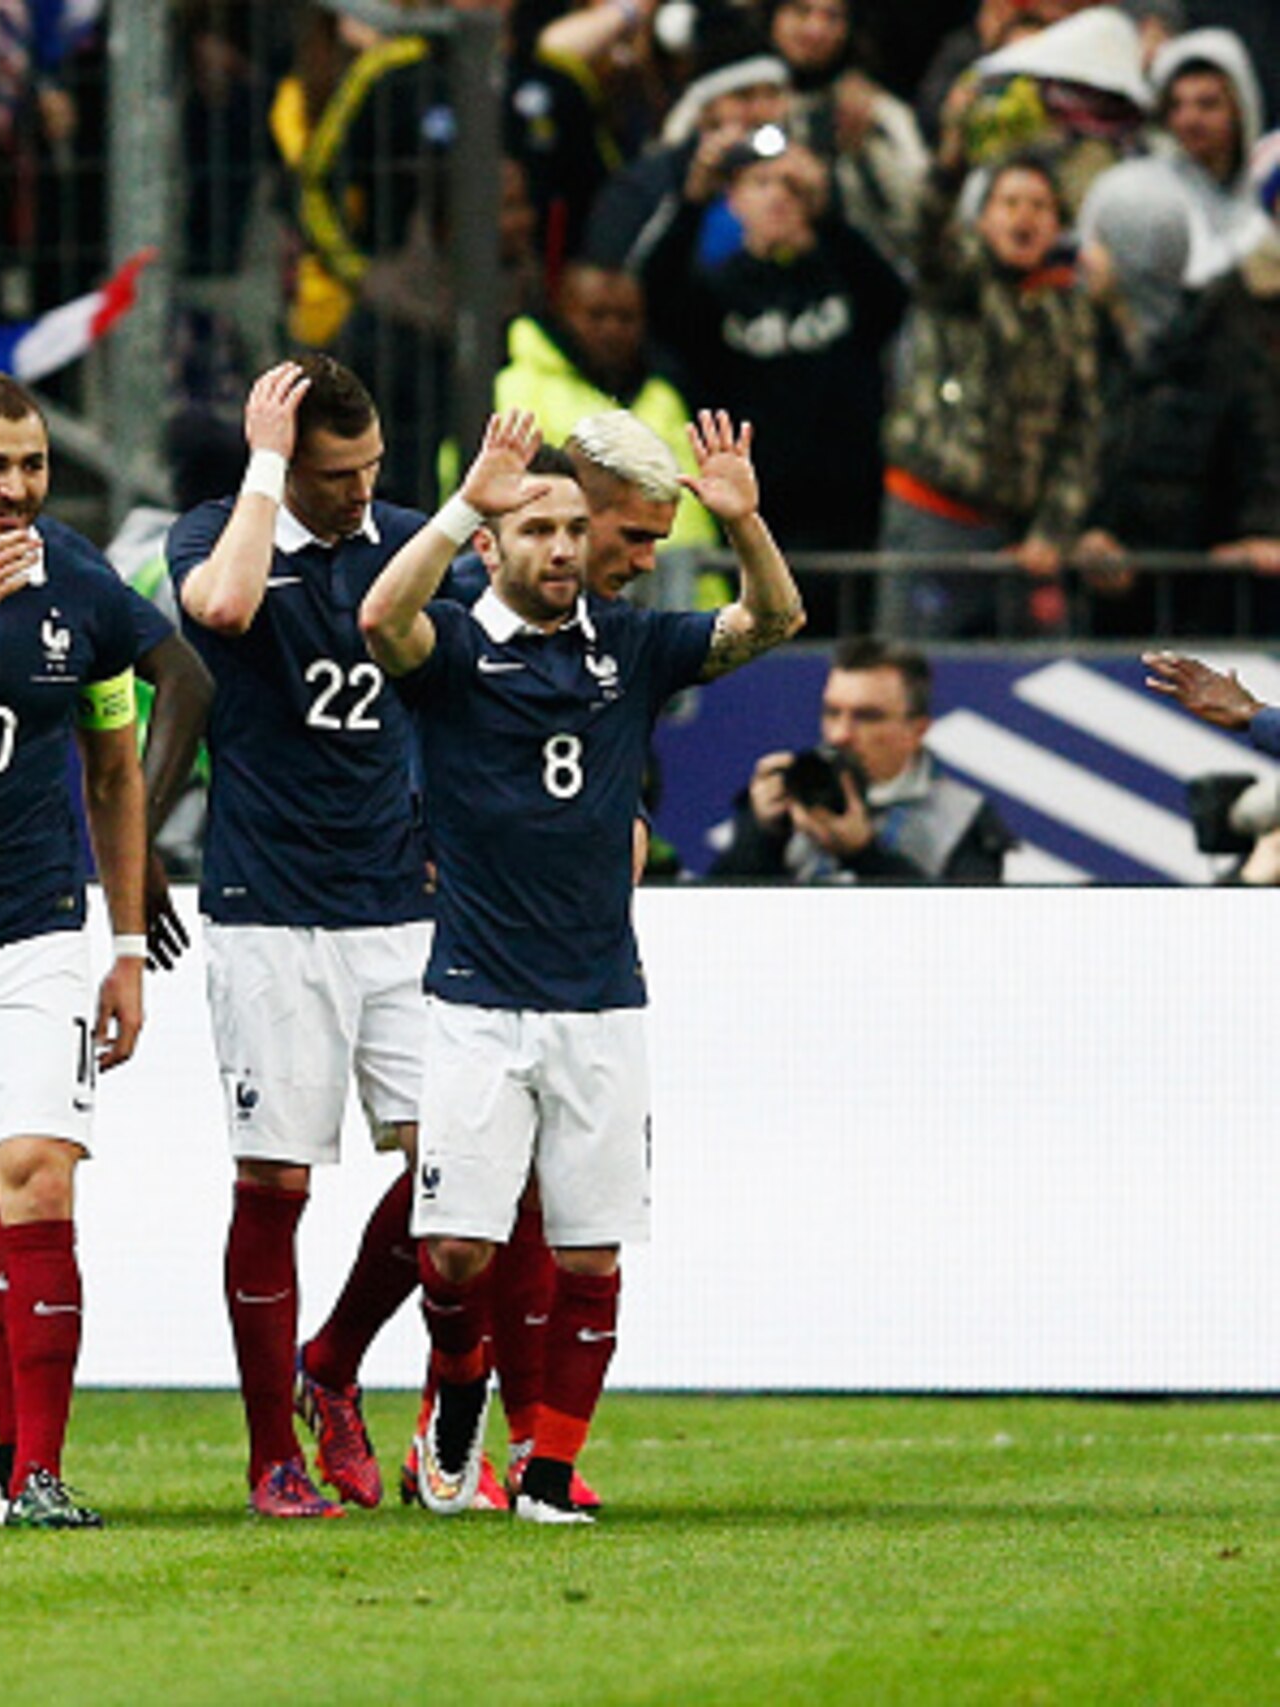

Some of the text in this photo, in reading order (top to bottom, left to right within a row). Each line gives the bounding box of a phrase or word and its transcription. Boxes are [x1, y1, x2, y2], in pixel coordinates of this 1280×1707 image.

[304, 658, 384, 730] 22
[542, 732, 583, 799] 8
[73, 1017, 95, 1090] 1
